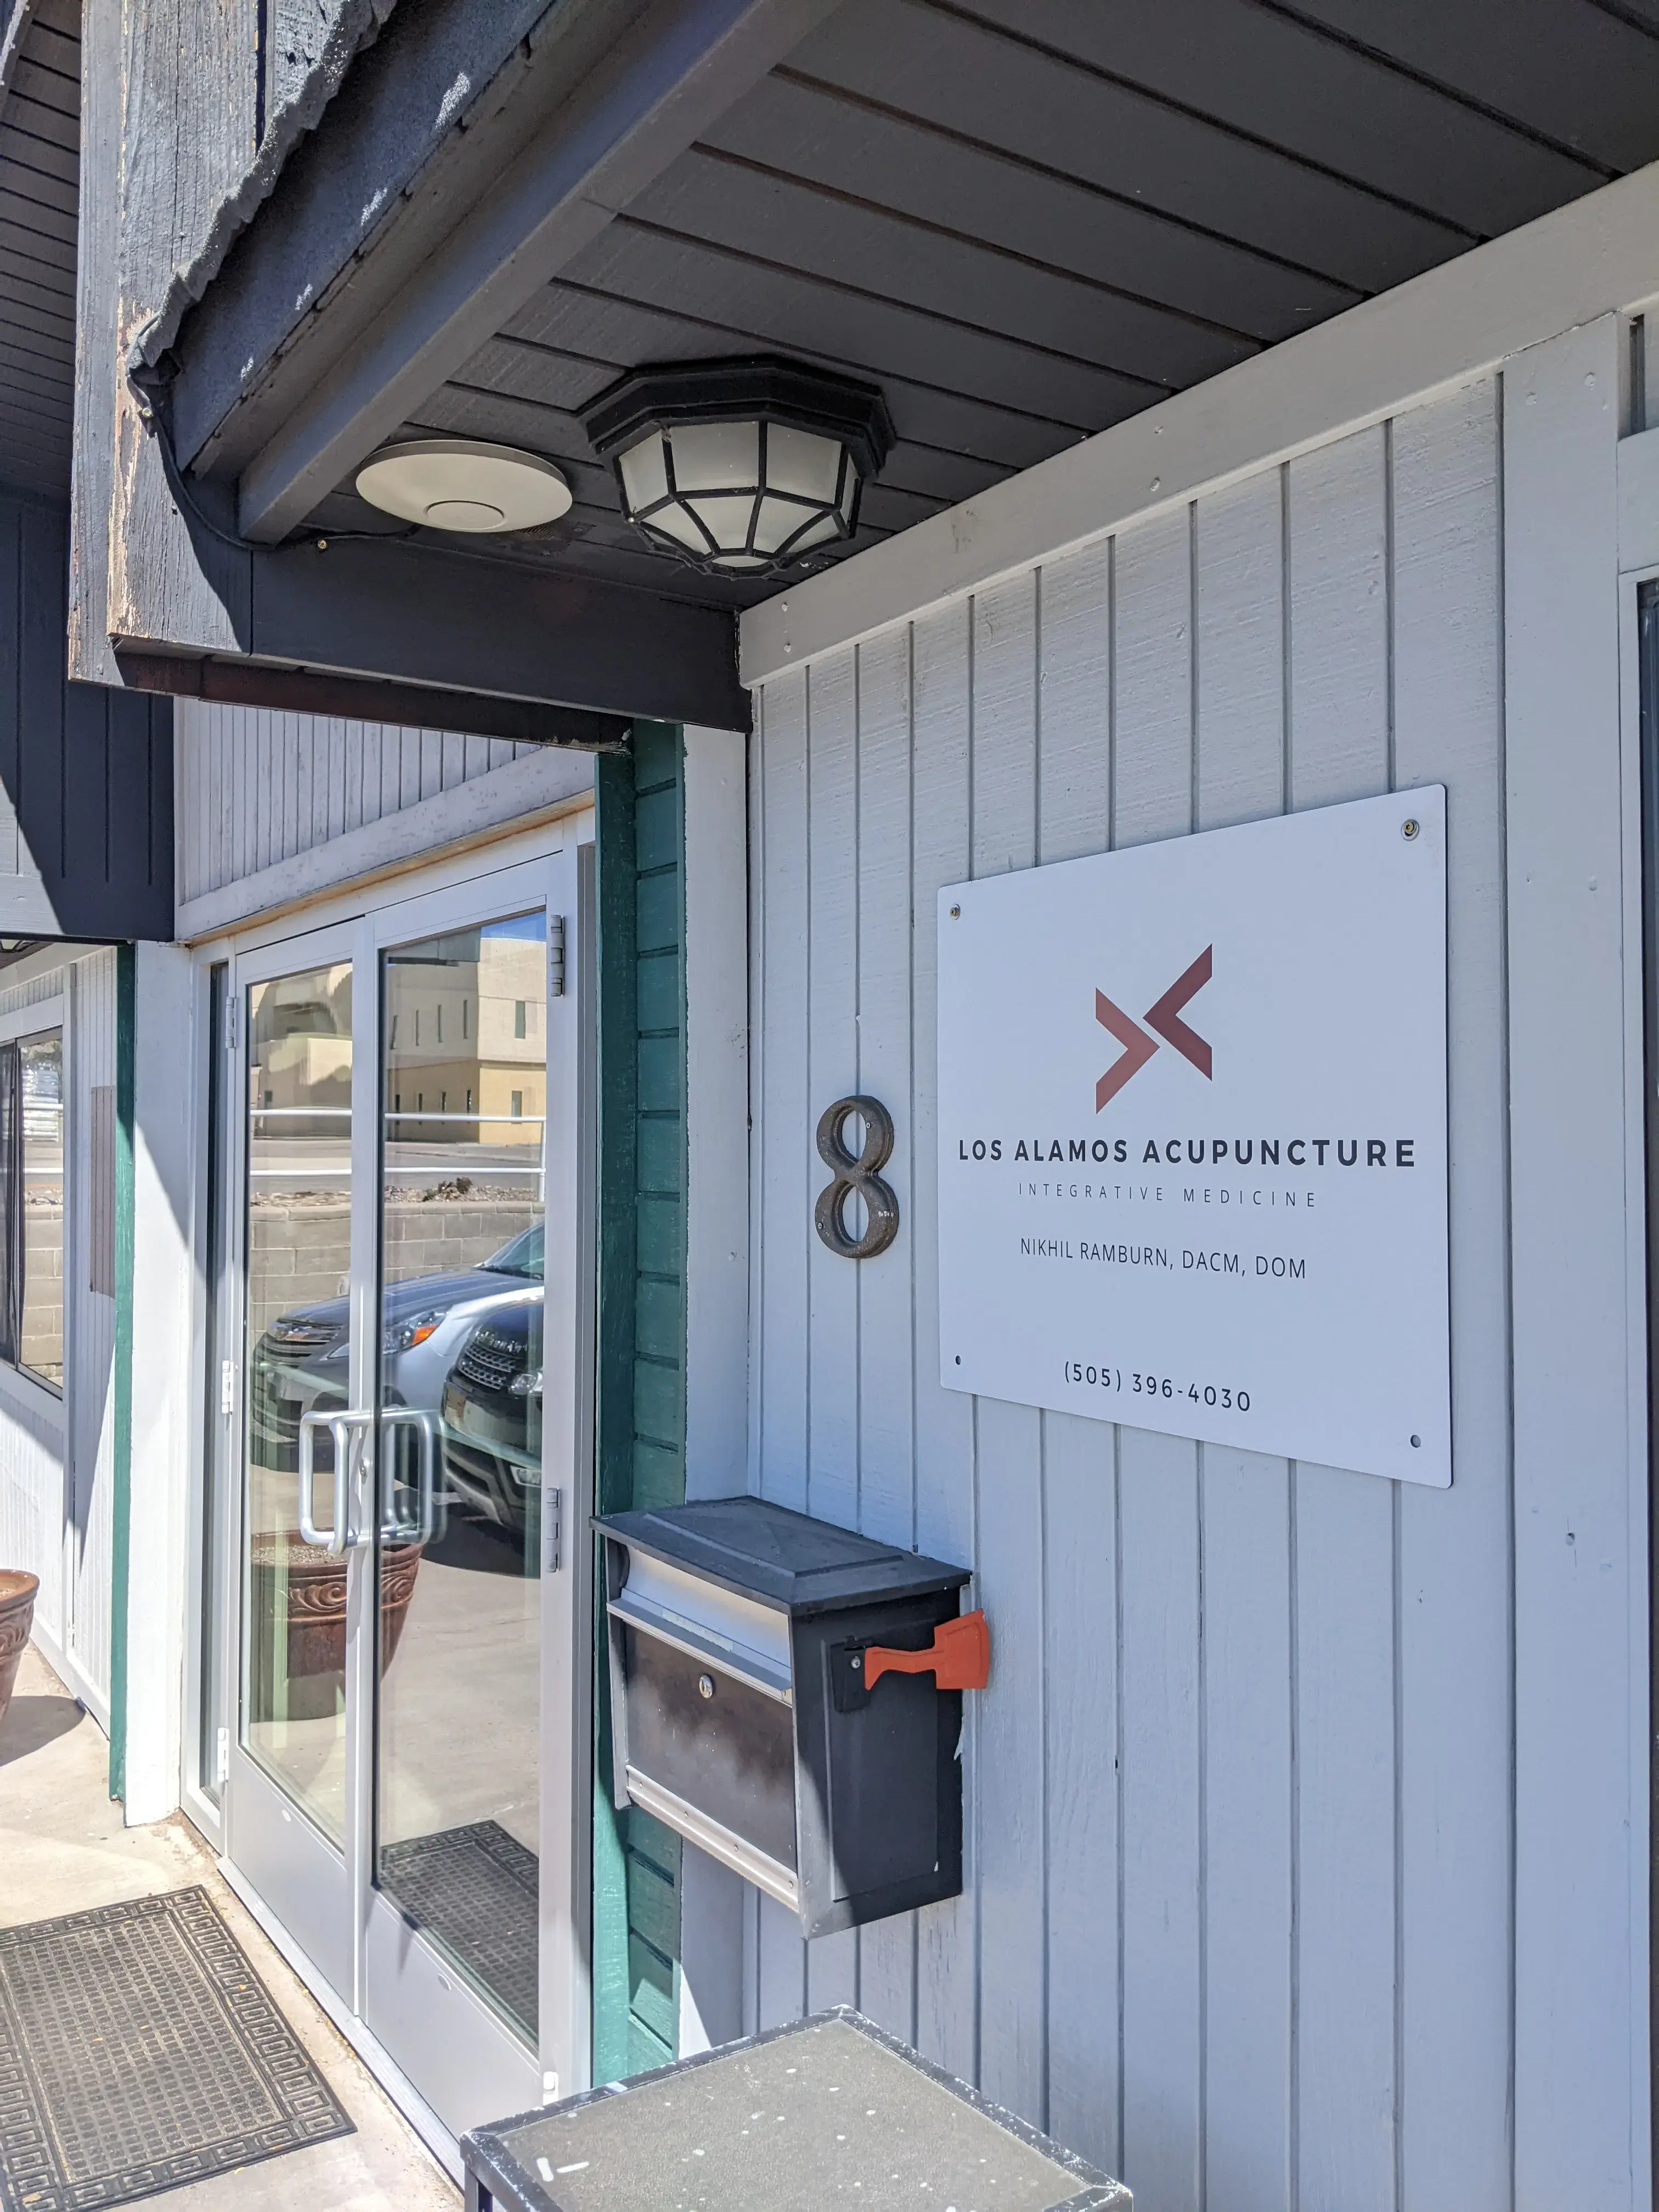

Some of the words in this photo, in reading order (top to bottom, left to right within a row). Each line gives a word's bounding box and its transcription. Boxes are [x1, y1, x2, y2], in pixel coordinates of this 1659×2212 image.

[959, 1139, 1002, 1161] LOS
[1014, 1139, 1127, 1163] ALAMOS
[1142, 1139, 1414, 1167] ACUPUNCTURE
[815, 1094, 899, 1259] 8
[1019, 1183, 1163, 1201] INTEGRATIVE
[1184, 1188, 1315, 1207] MEDICINE
[1021, 1238, 1073, 1259] NIKHIL
[1080, 1242, 1174, 1271] RAMBURN,
[1182, 1250, 1246, 1277] DACM,
[1256, 1256, 1306, 1279] DOM
[1065, 1361, 1121, 1392] (505)
[1132, 1373, 1251, 1412] 396-4030
